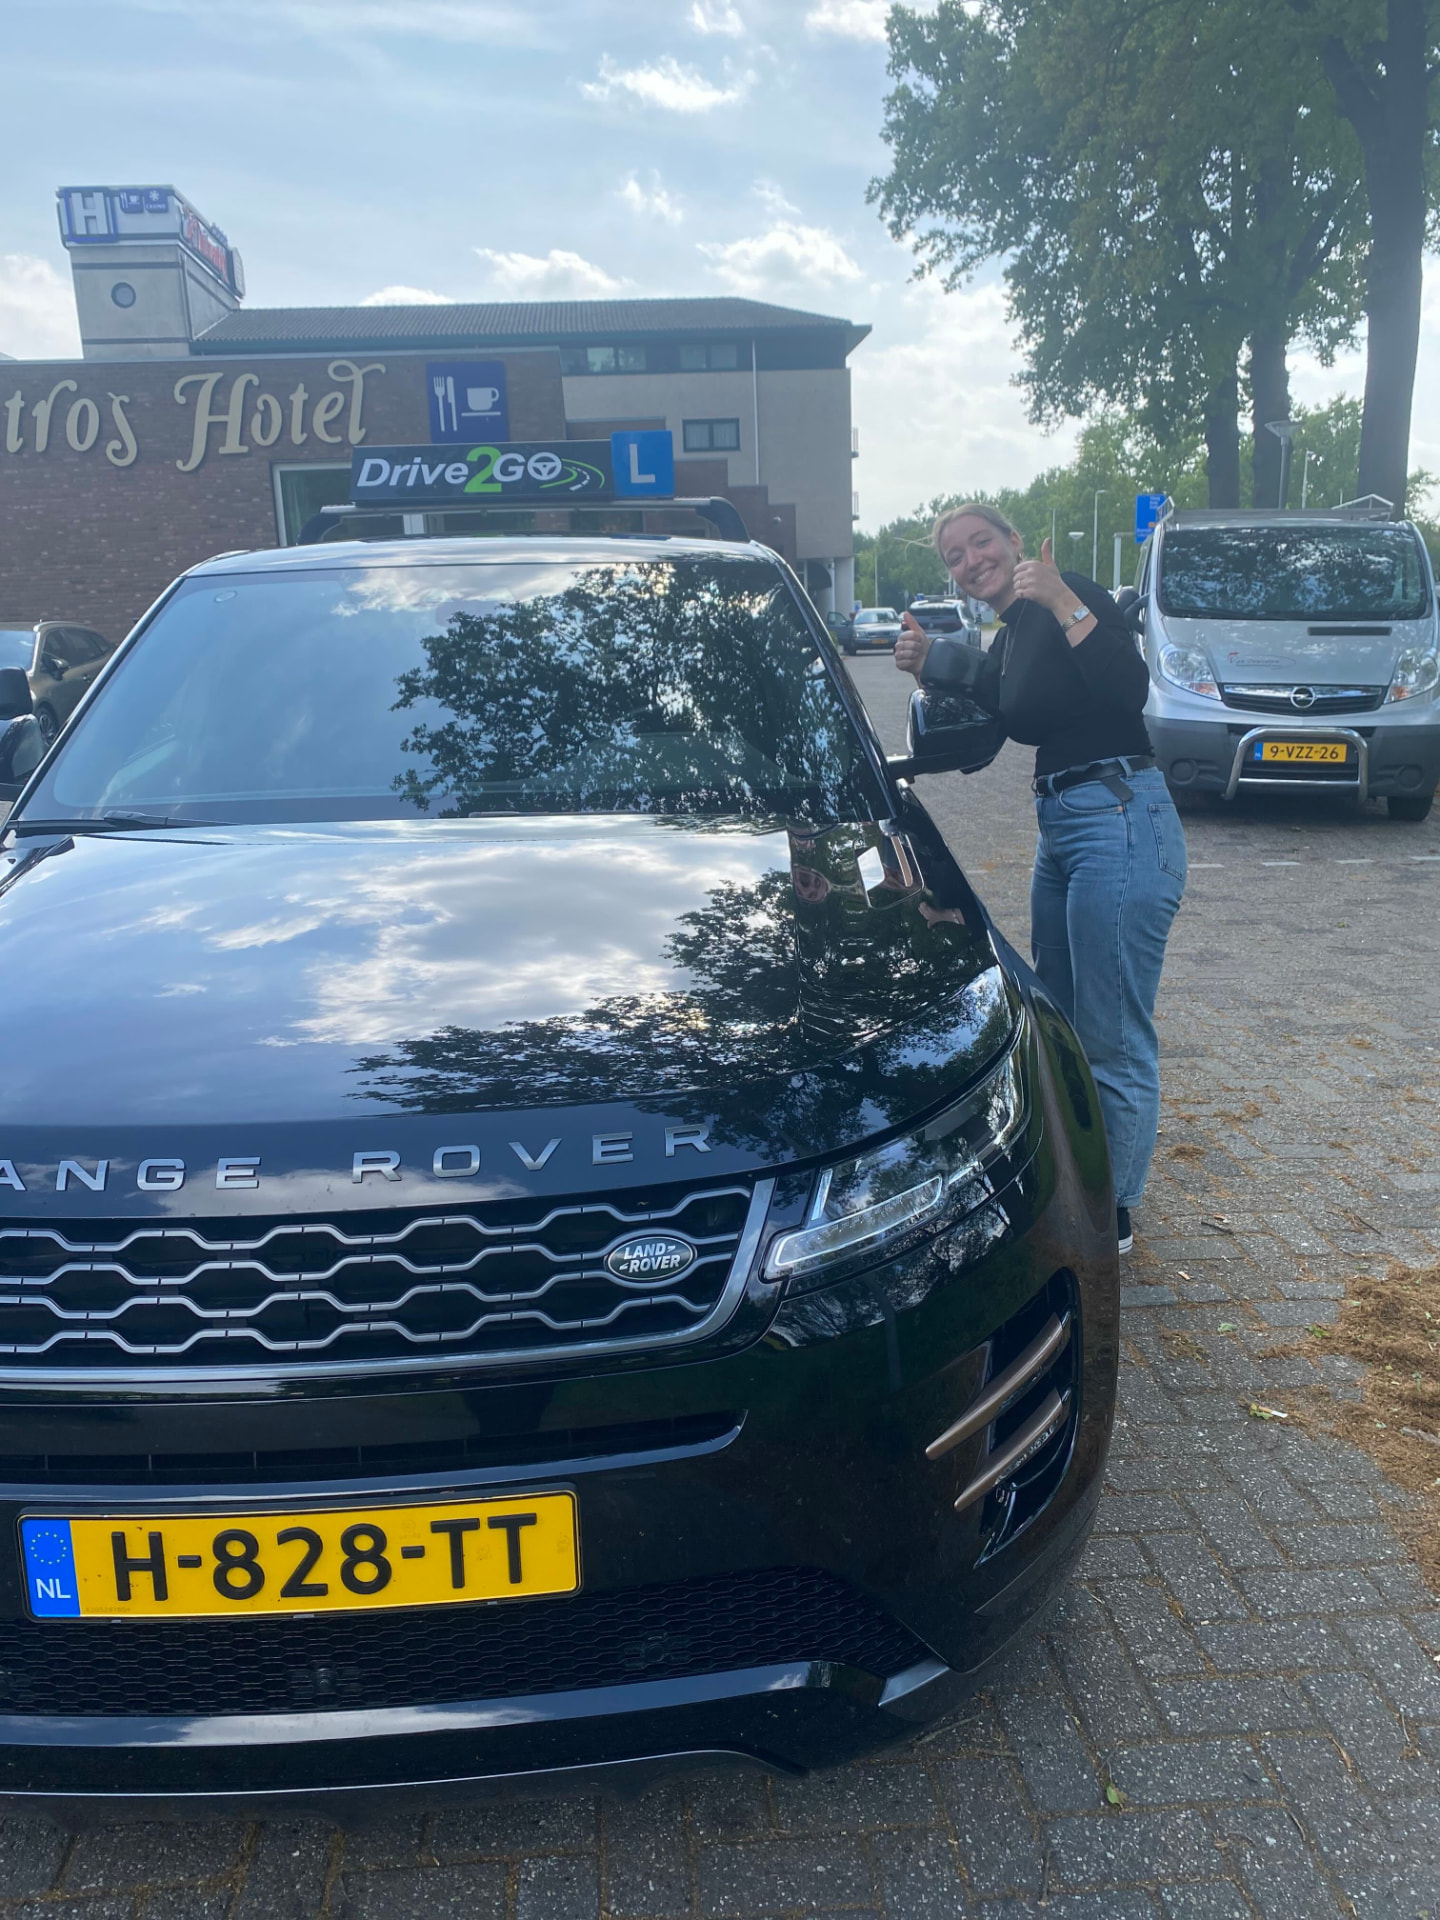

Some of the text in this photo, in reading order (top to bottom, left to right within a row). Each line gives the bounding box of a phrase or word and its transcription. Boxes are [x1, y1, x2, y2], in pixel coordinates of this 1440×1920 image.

[71, 192, 109, 235] H
[173, 359, 386, 472] Hotel
[629, 443, 656, 484] L
[1270, 745, 1339, 759] 9-VZZ-26
[352, 1123, 712, 1183] ROVER
[624, 1242, 666, 1260] LAND
[629, 1254, 681, 1273] ROVER
[111, 1512, 537, 1602] H-828-TT
[36, 1578, 71, 1599] NL
